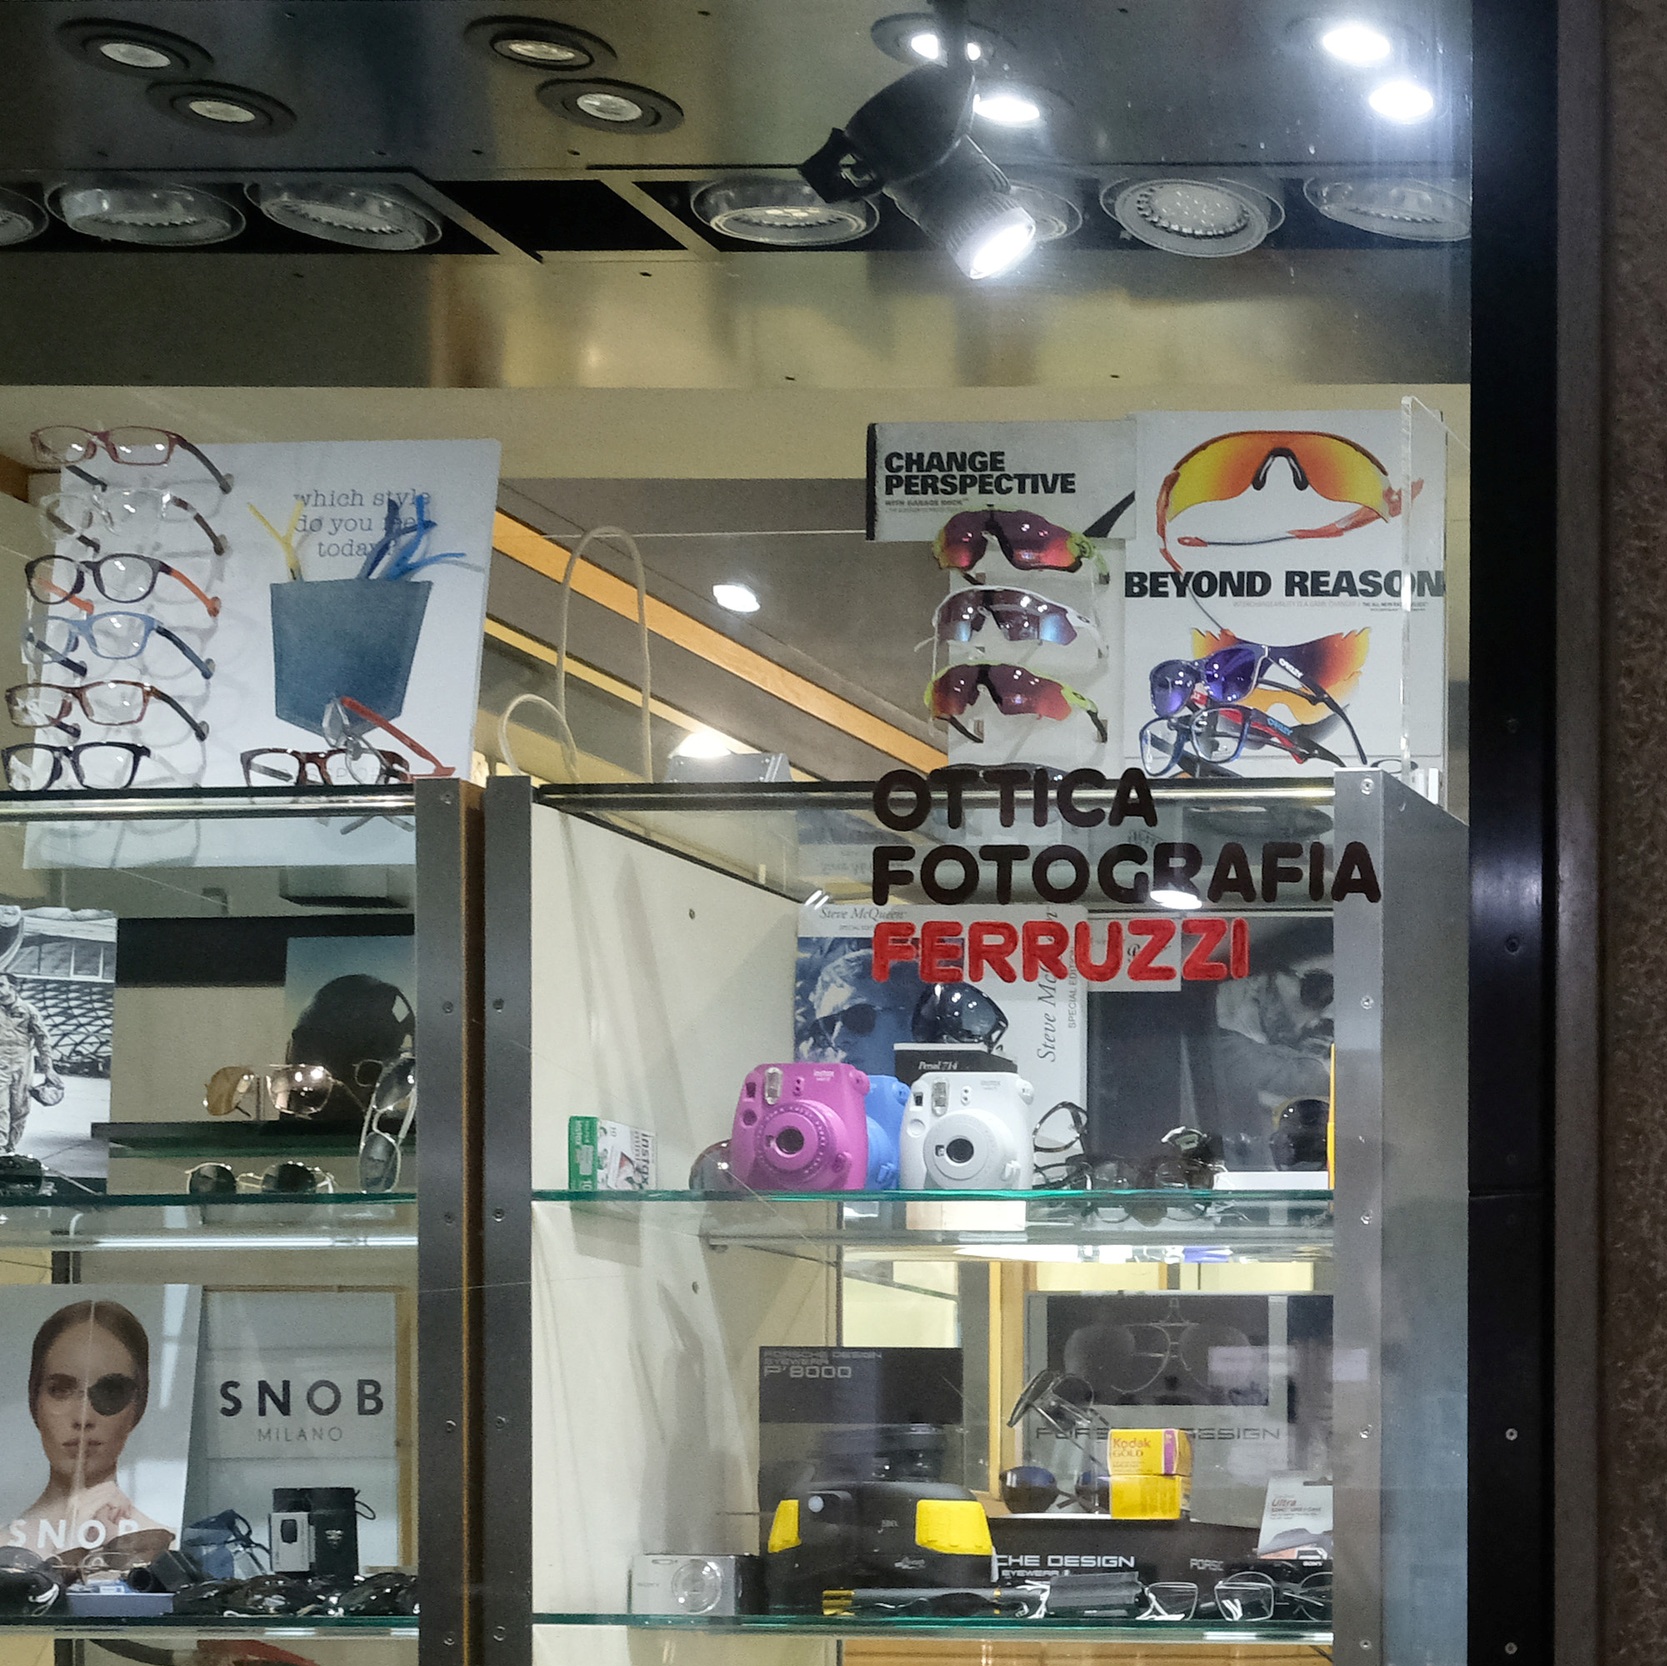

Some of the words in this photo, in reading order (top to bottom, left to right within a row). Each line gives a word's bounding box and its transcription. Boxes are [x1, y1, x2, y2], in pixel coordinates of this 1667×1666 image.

[884, 451, 1006, 473] CHANGE
[884, 473, 1076, 495] PERSPECTIVE
[293, 489, 364, 507] which
[328, 517, 373, 536] you
[1124, 570, 1272, 598] BEYOND
[1284, 570, 1445, 598] REASON
[872, 767, 1158, 831] OTTICA
[871, 841, 1381, 906] FOTOGRAFIA
[871, 917, 1250, 984] FERRUZZI
[1036, 1012, 1057, 1063] Steve
[220, 1379, 384, 1417] SNOB
[258, 1426, 343, 1442] MILANO
[1112, 1437, 1152, 1450] Kodak
[1112, 1450, 1144, 1458] GOLD
[1047, 1555, 1135, 1569] DESIGN
